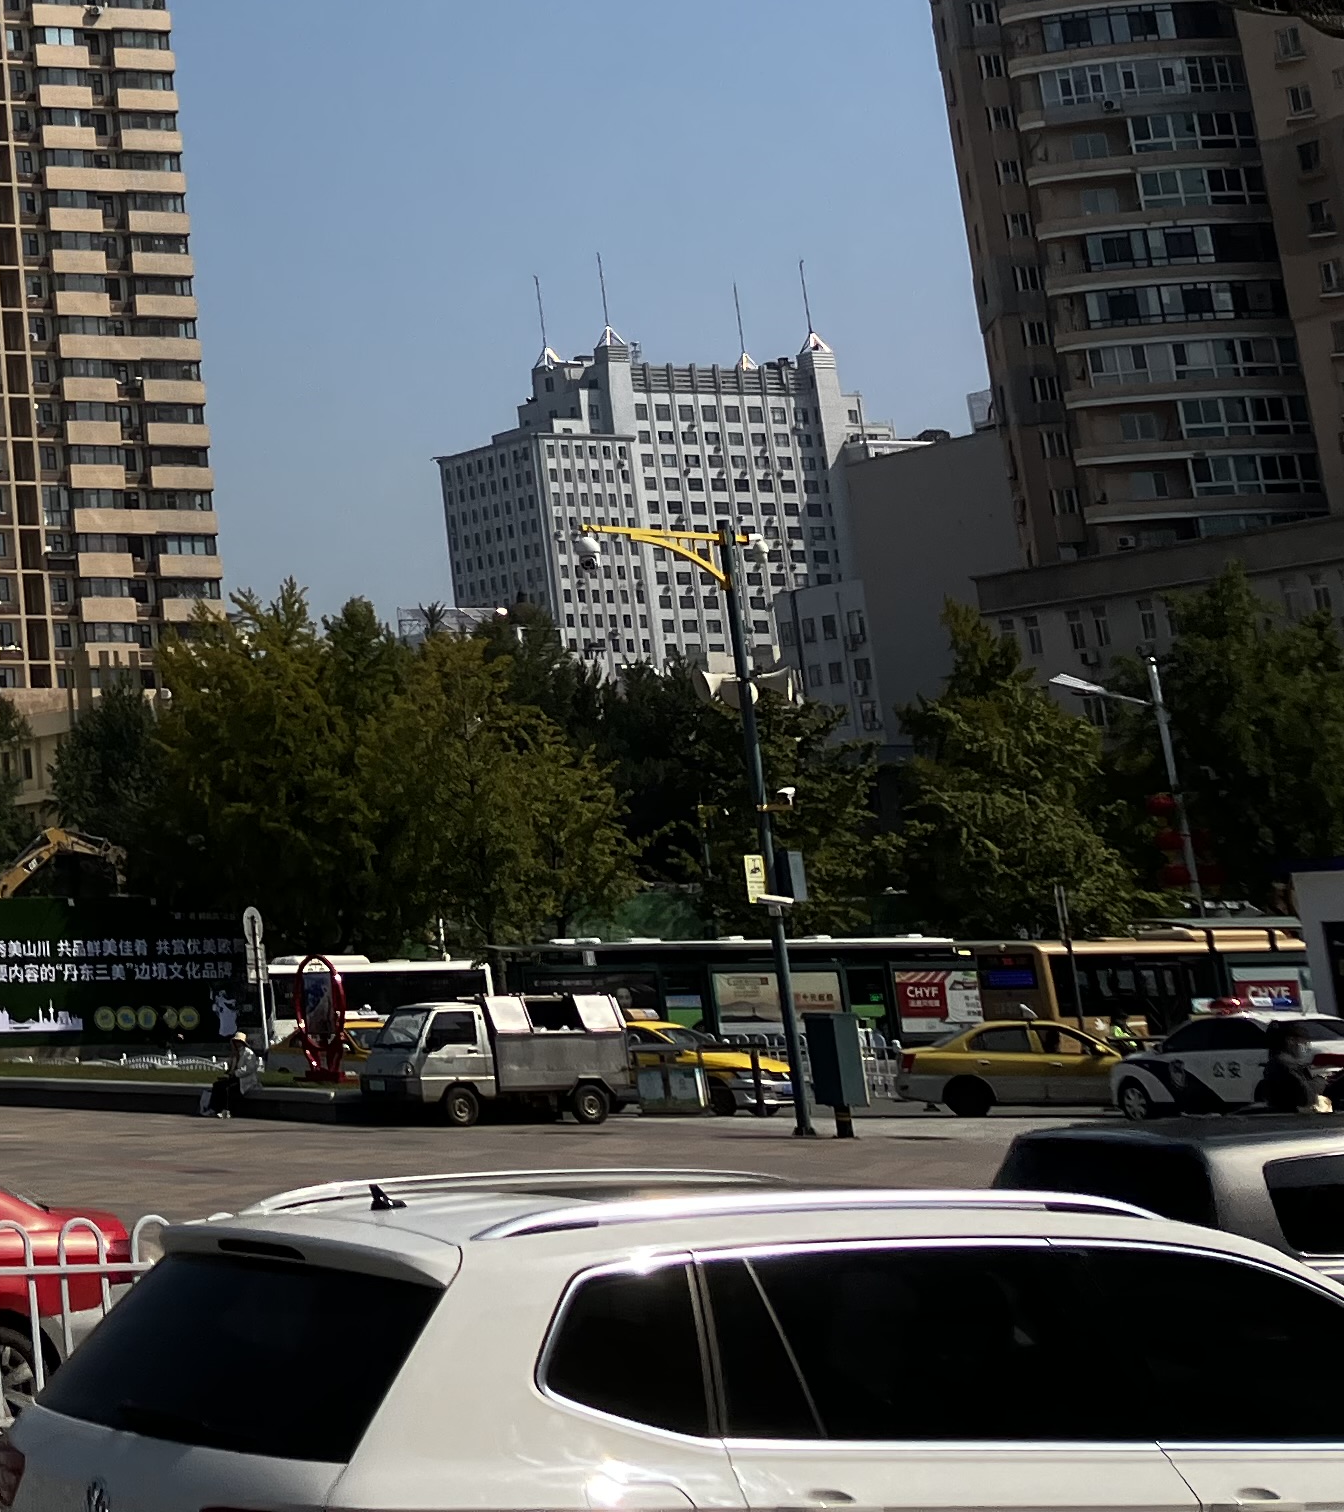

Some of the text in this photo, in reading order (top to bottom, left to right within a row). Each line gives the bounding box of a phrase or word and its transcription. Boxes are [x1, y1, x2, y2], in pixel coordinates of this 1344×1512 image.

[56, 938, 148, 957] 共品鲜美佳肴
[906, 986, 939, 999] CHYF
[1212, 1060, 1243, 1079] 公安
